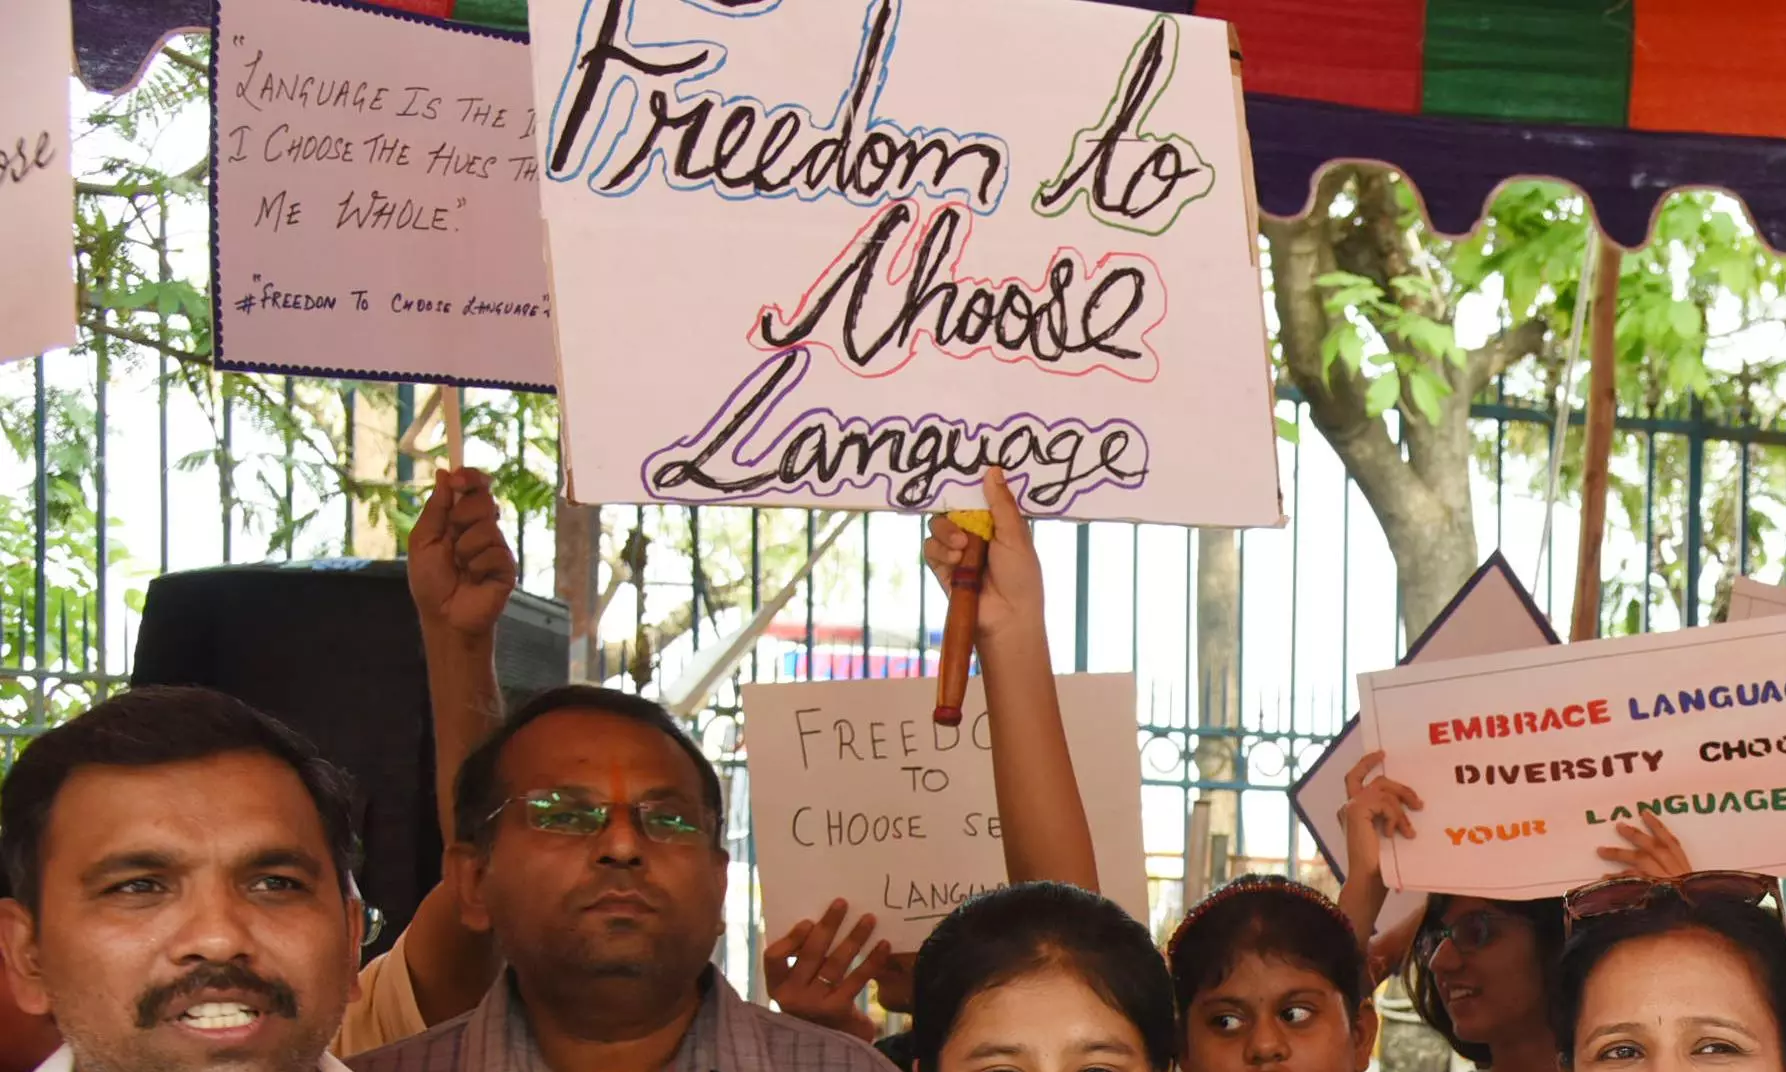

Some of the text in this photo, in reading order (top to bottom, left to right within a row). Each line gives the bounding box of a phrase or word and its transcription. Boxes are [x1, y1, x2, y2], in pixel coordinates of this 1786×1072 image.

[396, 86, 442, 120] IS
[456, 97, 508, 130] THE
[551, 0, 1198, 218] Freedom to
[228, 124, 540, 182] I CHOOSE THE HUES TH
[254, 194, 302, 228] ME
[390, 296, 452, 314] CHOOSE
[654, 347, 1148, 508] Language
[795, 706, 993, 771] FREEDO
[1428, 699, 1612, 747] EMBRACE
[900, 766, 950, 793] TO
[1454, 749, 1664, 786] DIVERSITY
[791, 805, 928, 847] CHOOSE
[1444, 817, 1547, 847] YOUR
